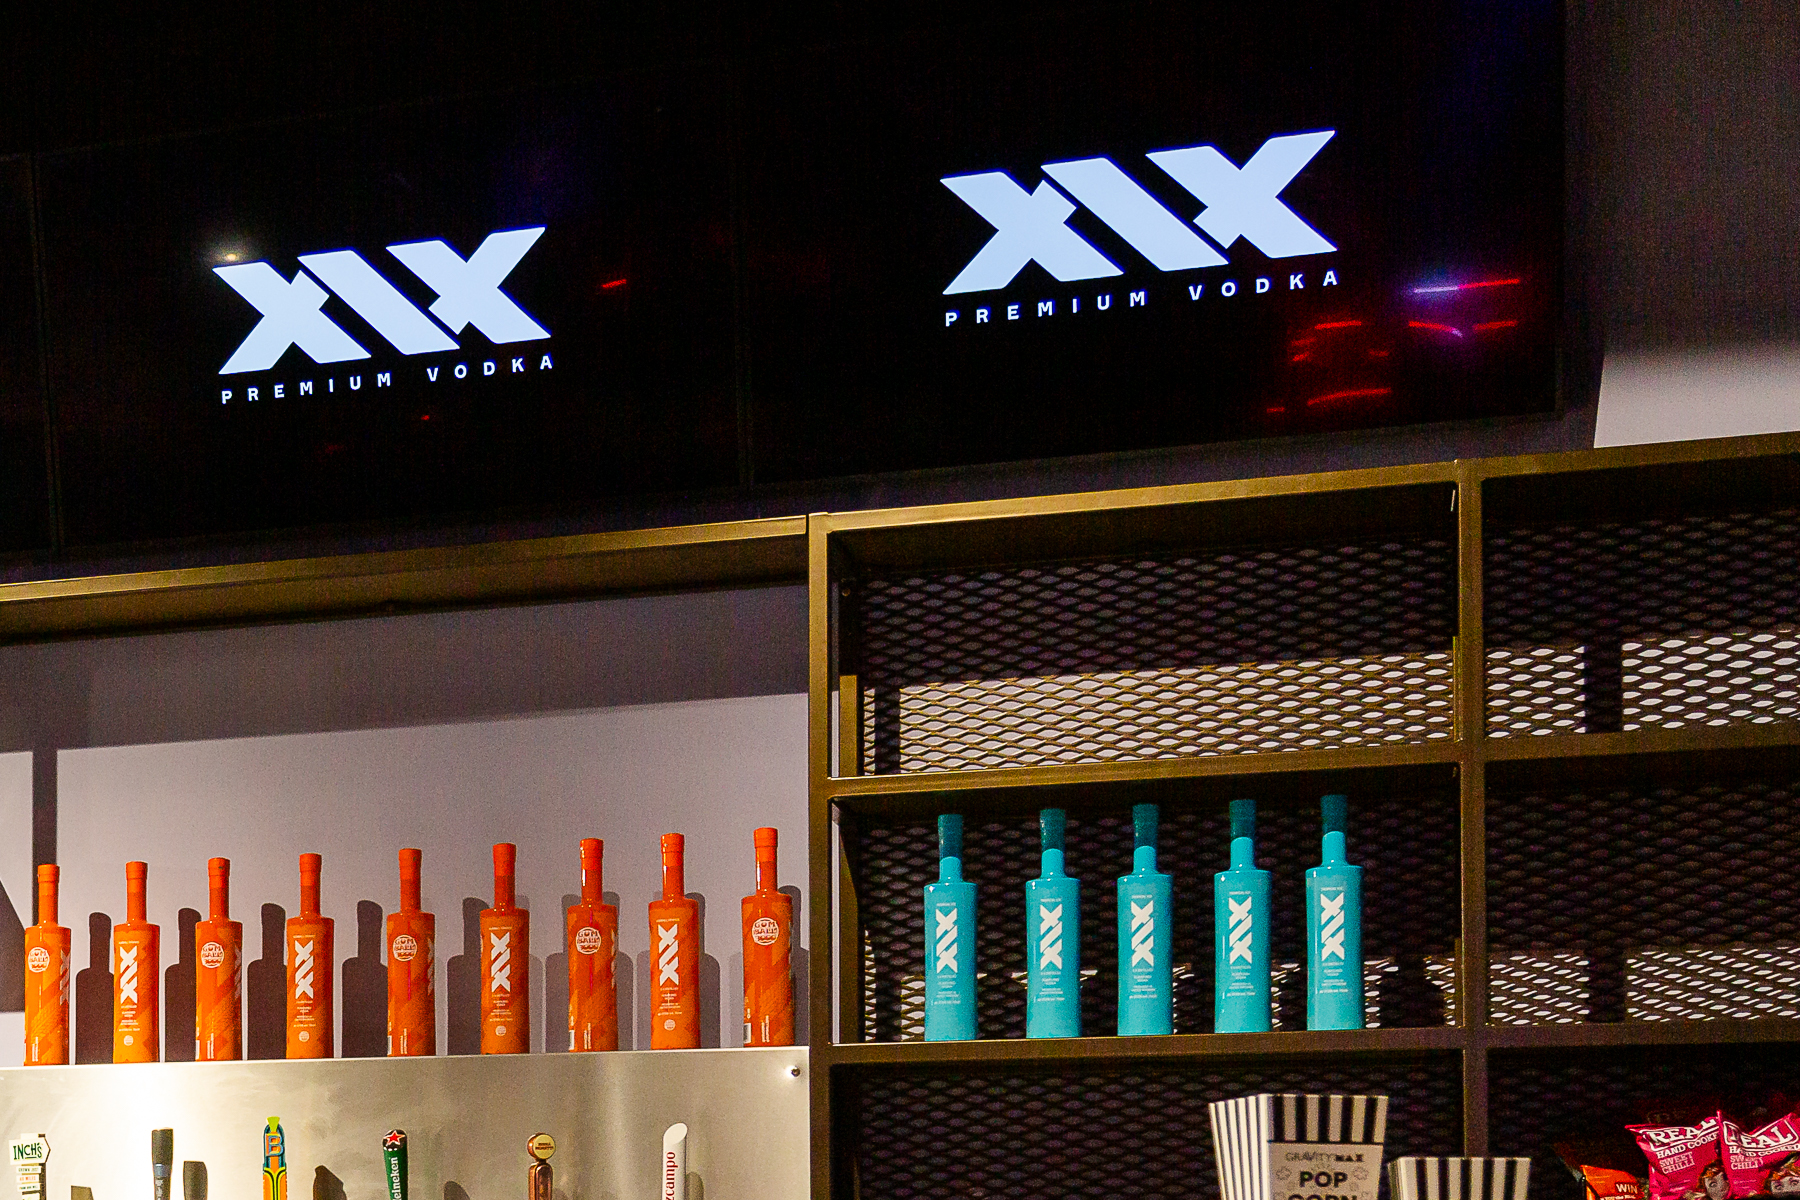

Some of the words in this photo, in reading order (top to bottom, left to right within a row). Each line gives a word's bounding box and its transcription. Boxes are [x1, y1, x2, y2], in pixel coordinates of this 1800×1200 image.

[945, 291, 1145, 327] PREMIUM
[1188, 270, 1338, 301] VODKA
[221, 372, 391, 405] PREMIUM
[426, 355, 553, 382] VODKA
[1647, 1118, 1717, 1147] REAL
[1656, 1143, 1686, 1159] HAND
[1659, 1152, 1693, 1168] SWEET
[1661, 1159, 1695, 1175] CHILLI
[1300, 1171, 1348, 1188] POP
[1615, 1183, 1639, 1194] WIN
